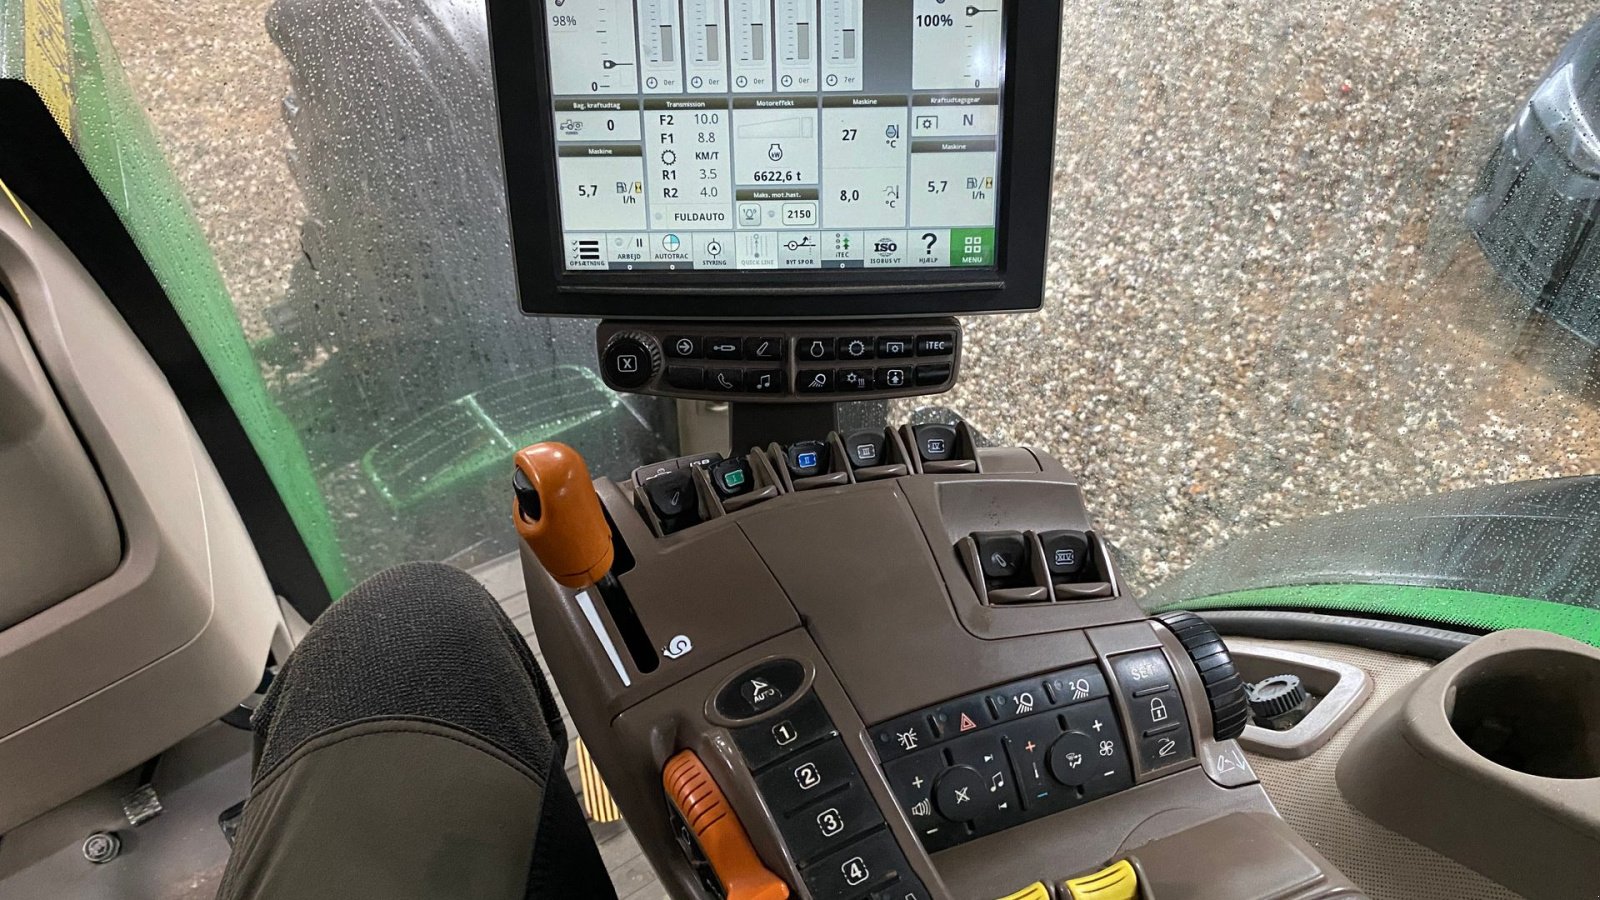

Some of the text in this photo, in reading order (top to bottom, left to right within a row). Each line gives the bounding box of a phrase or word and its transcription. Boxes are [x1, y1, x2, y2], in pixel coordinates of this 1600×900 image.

[552, 15, 577, 27] 98%
[916, 14, 954, 27] 100%
[591, 81, 598, 92] 0
[974, 80, 980, 88] 0
[930, 96, 981, 105] Kraftudtagsgear
[659, 115, 674, 125] F2
[694, 113, 719, 125] 10.0
[963, 114, 974, 126] N
[607, 119, 615, 131] 0
[660, 133, 674, 144] F1
[697, 132, 716, 143] 8.8
[841, 129, 857, 141] 27
[941, 143, 967, 151] Maskine
[695, 151, 720, 161] KM/T
[662, 170, 677, 180] R1
[699, 168, 718, 179] 3.5
[753, 171, 802, 182] 6622,6 t
[578, 185, 598, 198] 5,7
[663, 187, 679, 198] R2
[699, 187, 718, 198] 4.0
[927, 181, 948, 194] 5,7
[839, 190, 860, 203] 8,0
[674, 213, 725, 221] FULDAUTO
[787, 210, 811, 219] 2150
[873, 243, 898, 252] ISO
[926, 340, 945, 350] iTEC
[623, 357, 632, 368] X
[1057, 551, 1073, 563] XIV
[1131, 664, 1154, 680] SET
[1069, 682, 1076, 691] 2
[754, 689, 774, 703] AUTO
[1013, 695, 1019, 704] 1
[779, 725, 790, 740] 1
[801, 768, 815, 785] 2
[824, 814, 837, 831] 3
[850, 863, 862, 879] 4
